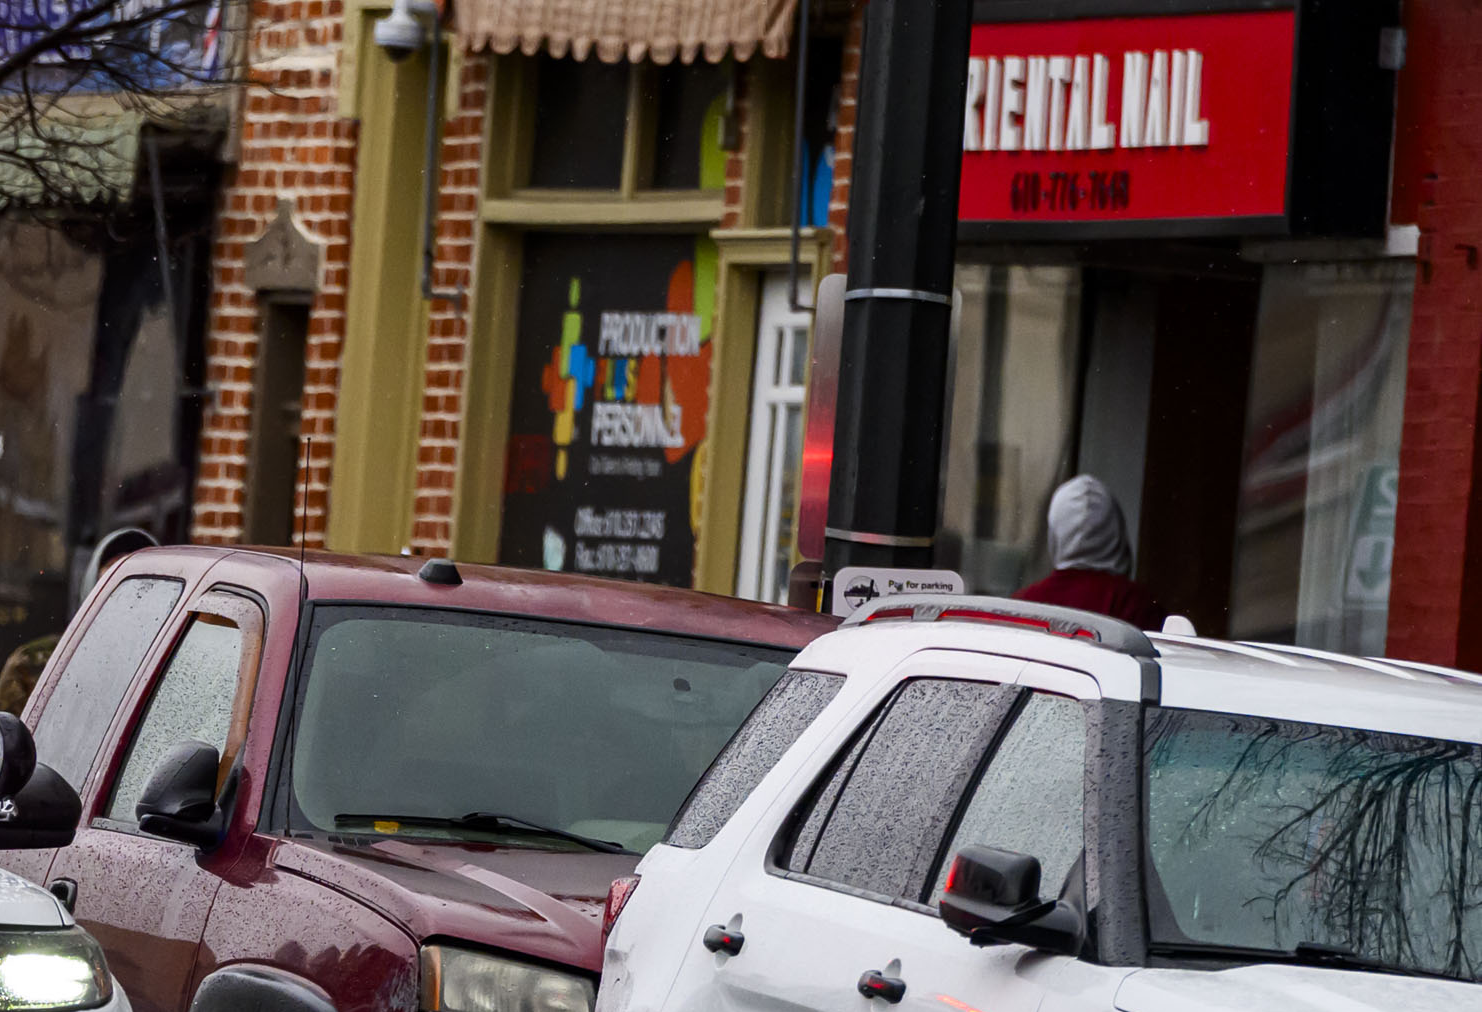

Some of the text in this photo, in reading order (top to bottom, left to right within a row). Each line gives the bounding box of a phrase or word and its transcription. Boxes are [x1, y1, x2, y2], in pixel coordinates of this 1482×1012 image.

[1120, 49, 1210, 149] NAIL
[598, 313, 702, 356] PRODUCTION
[906, 581, 919, 590] for
[921, 582, 954, 592] parking
